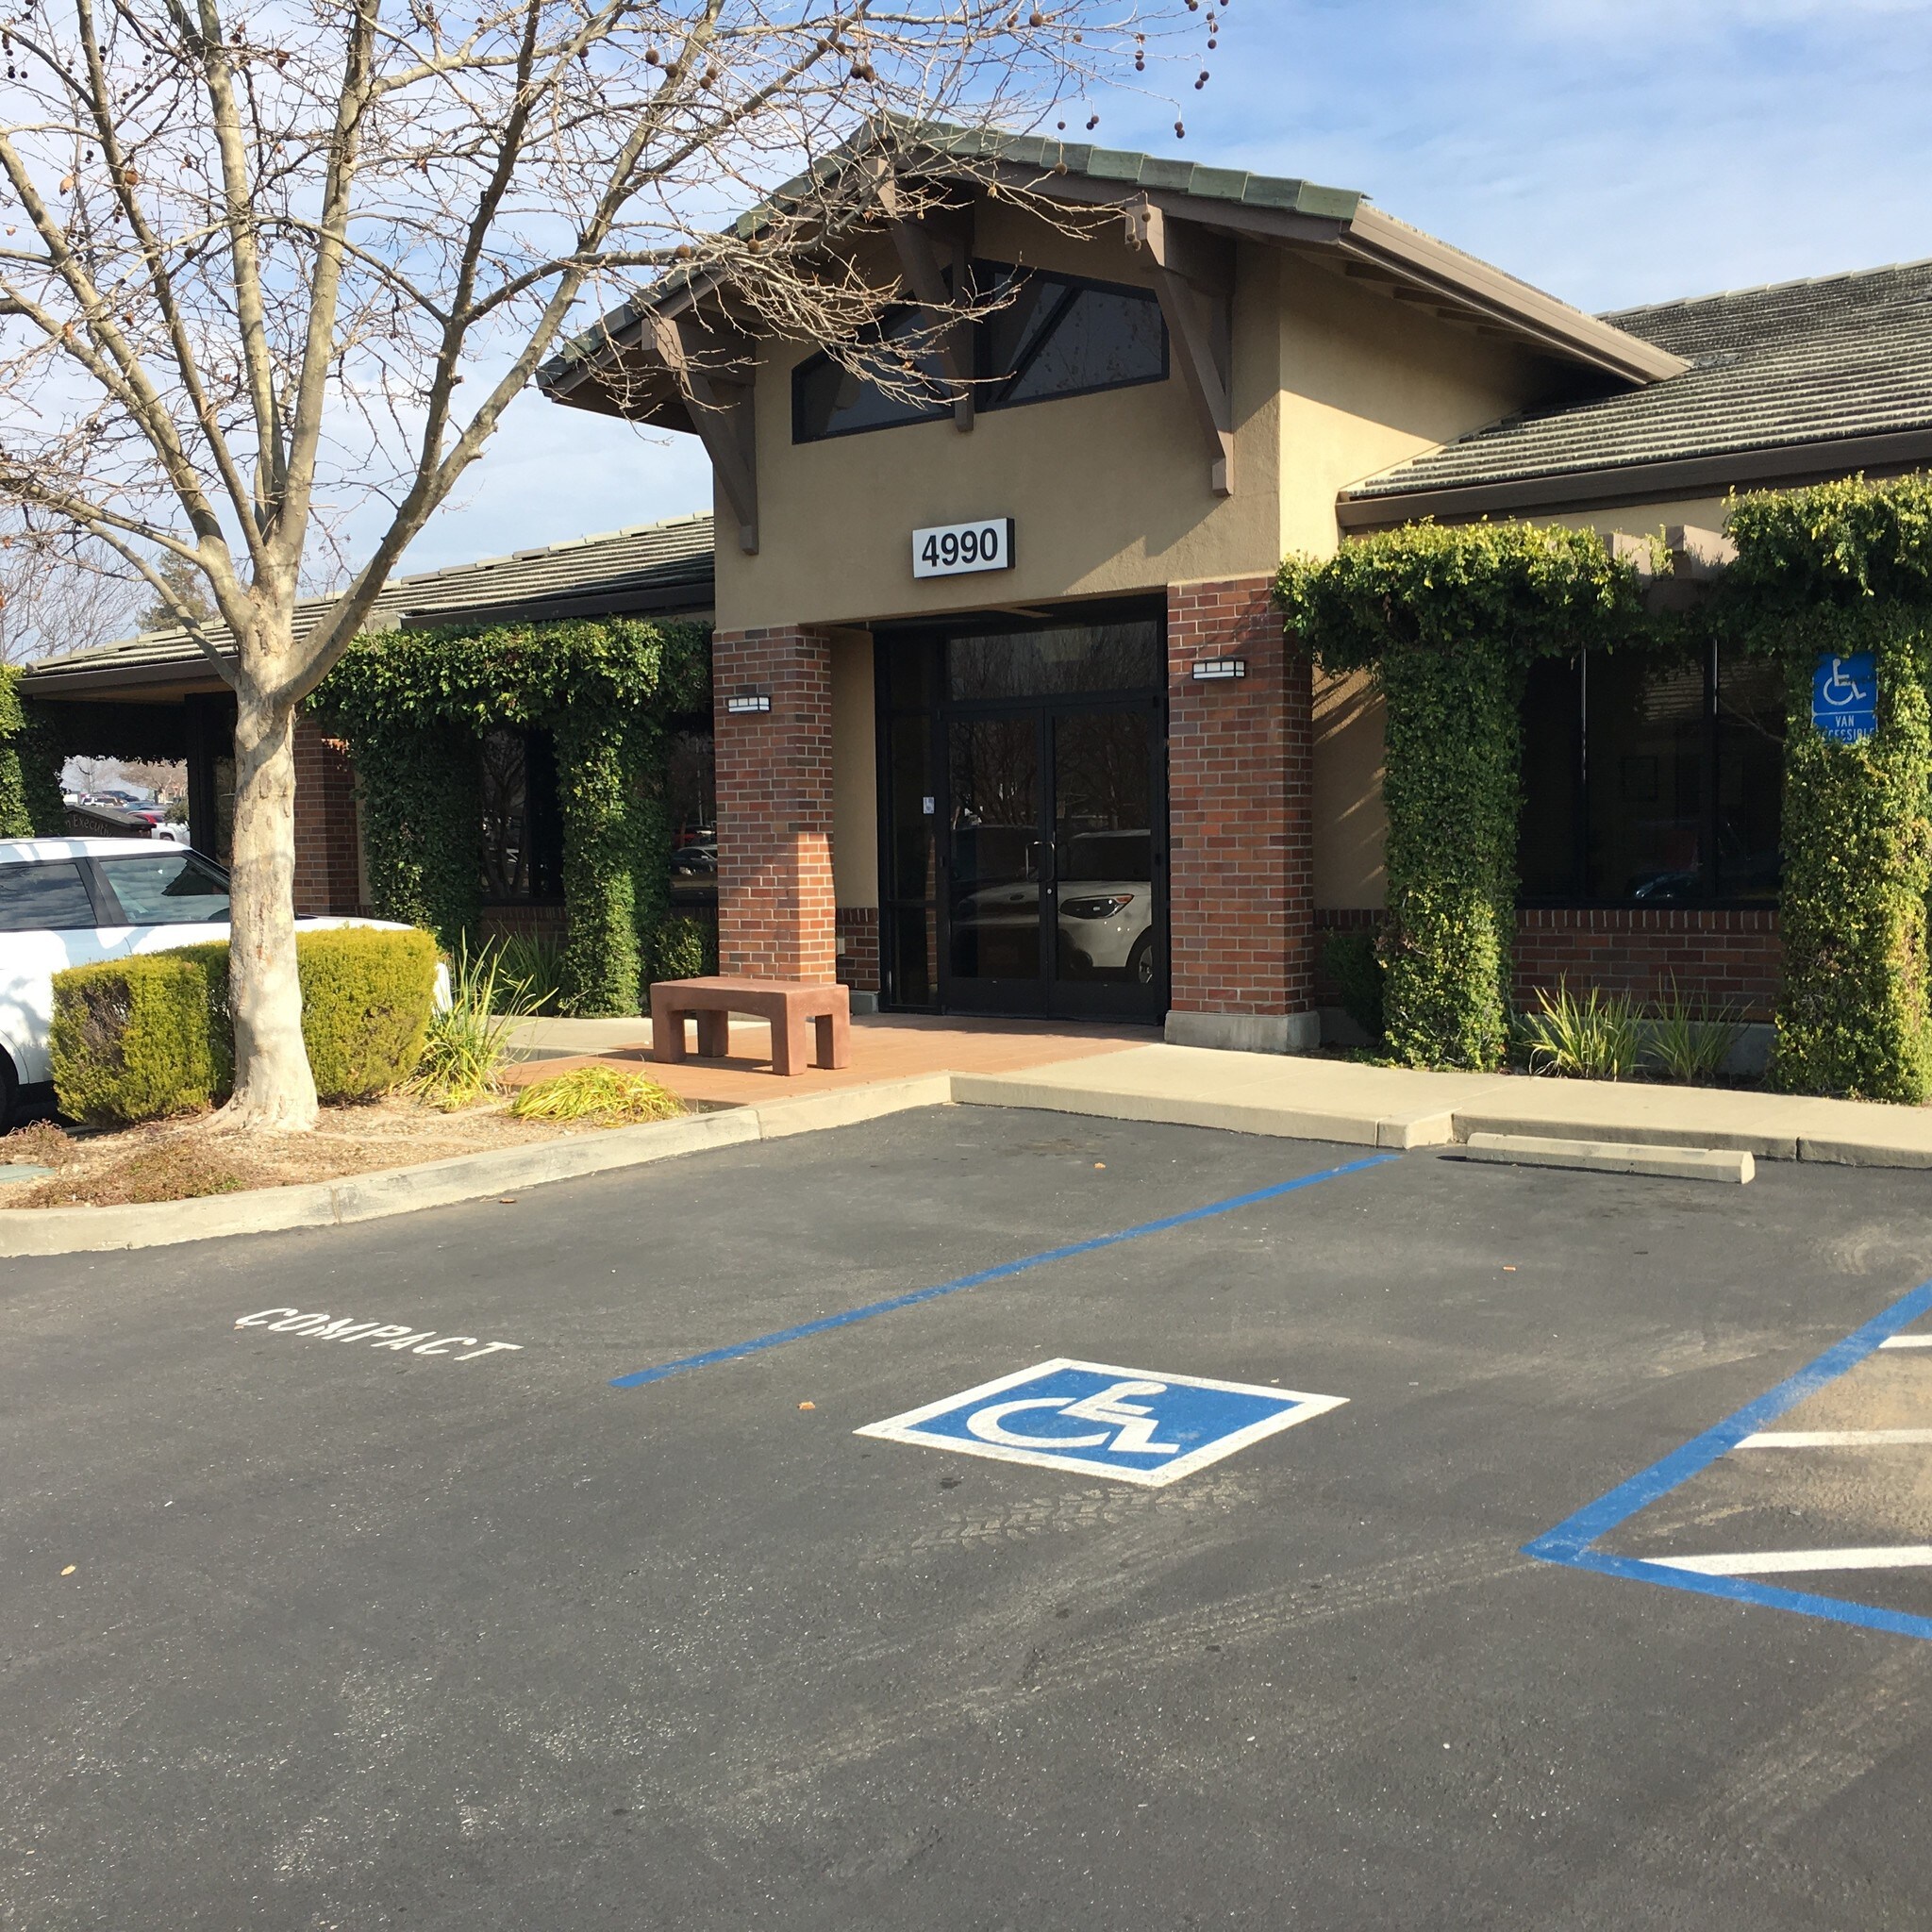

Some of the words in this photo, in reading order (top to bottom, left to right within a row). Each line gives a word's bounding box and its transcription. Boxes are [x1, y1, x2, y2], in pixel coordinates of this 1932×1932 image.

[922, 527, 998, 567] 4990
[1835, 714, 1855, 727] VAN
[74, 814, 113, 837] Executiv
[236, 1307, 524, 1360] COMPACT
